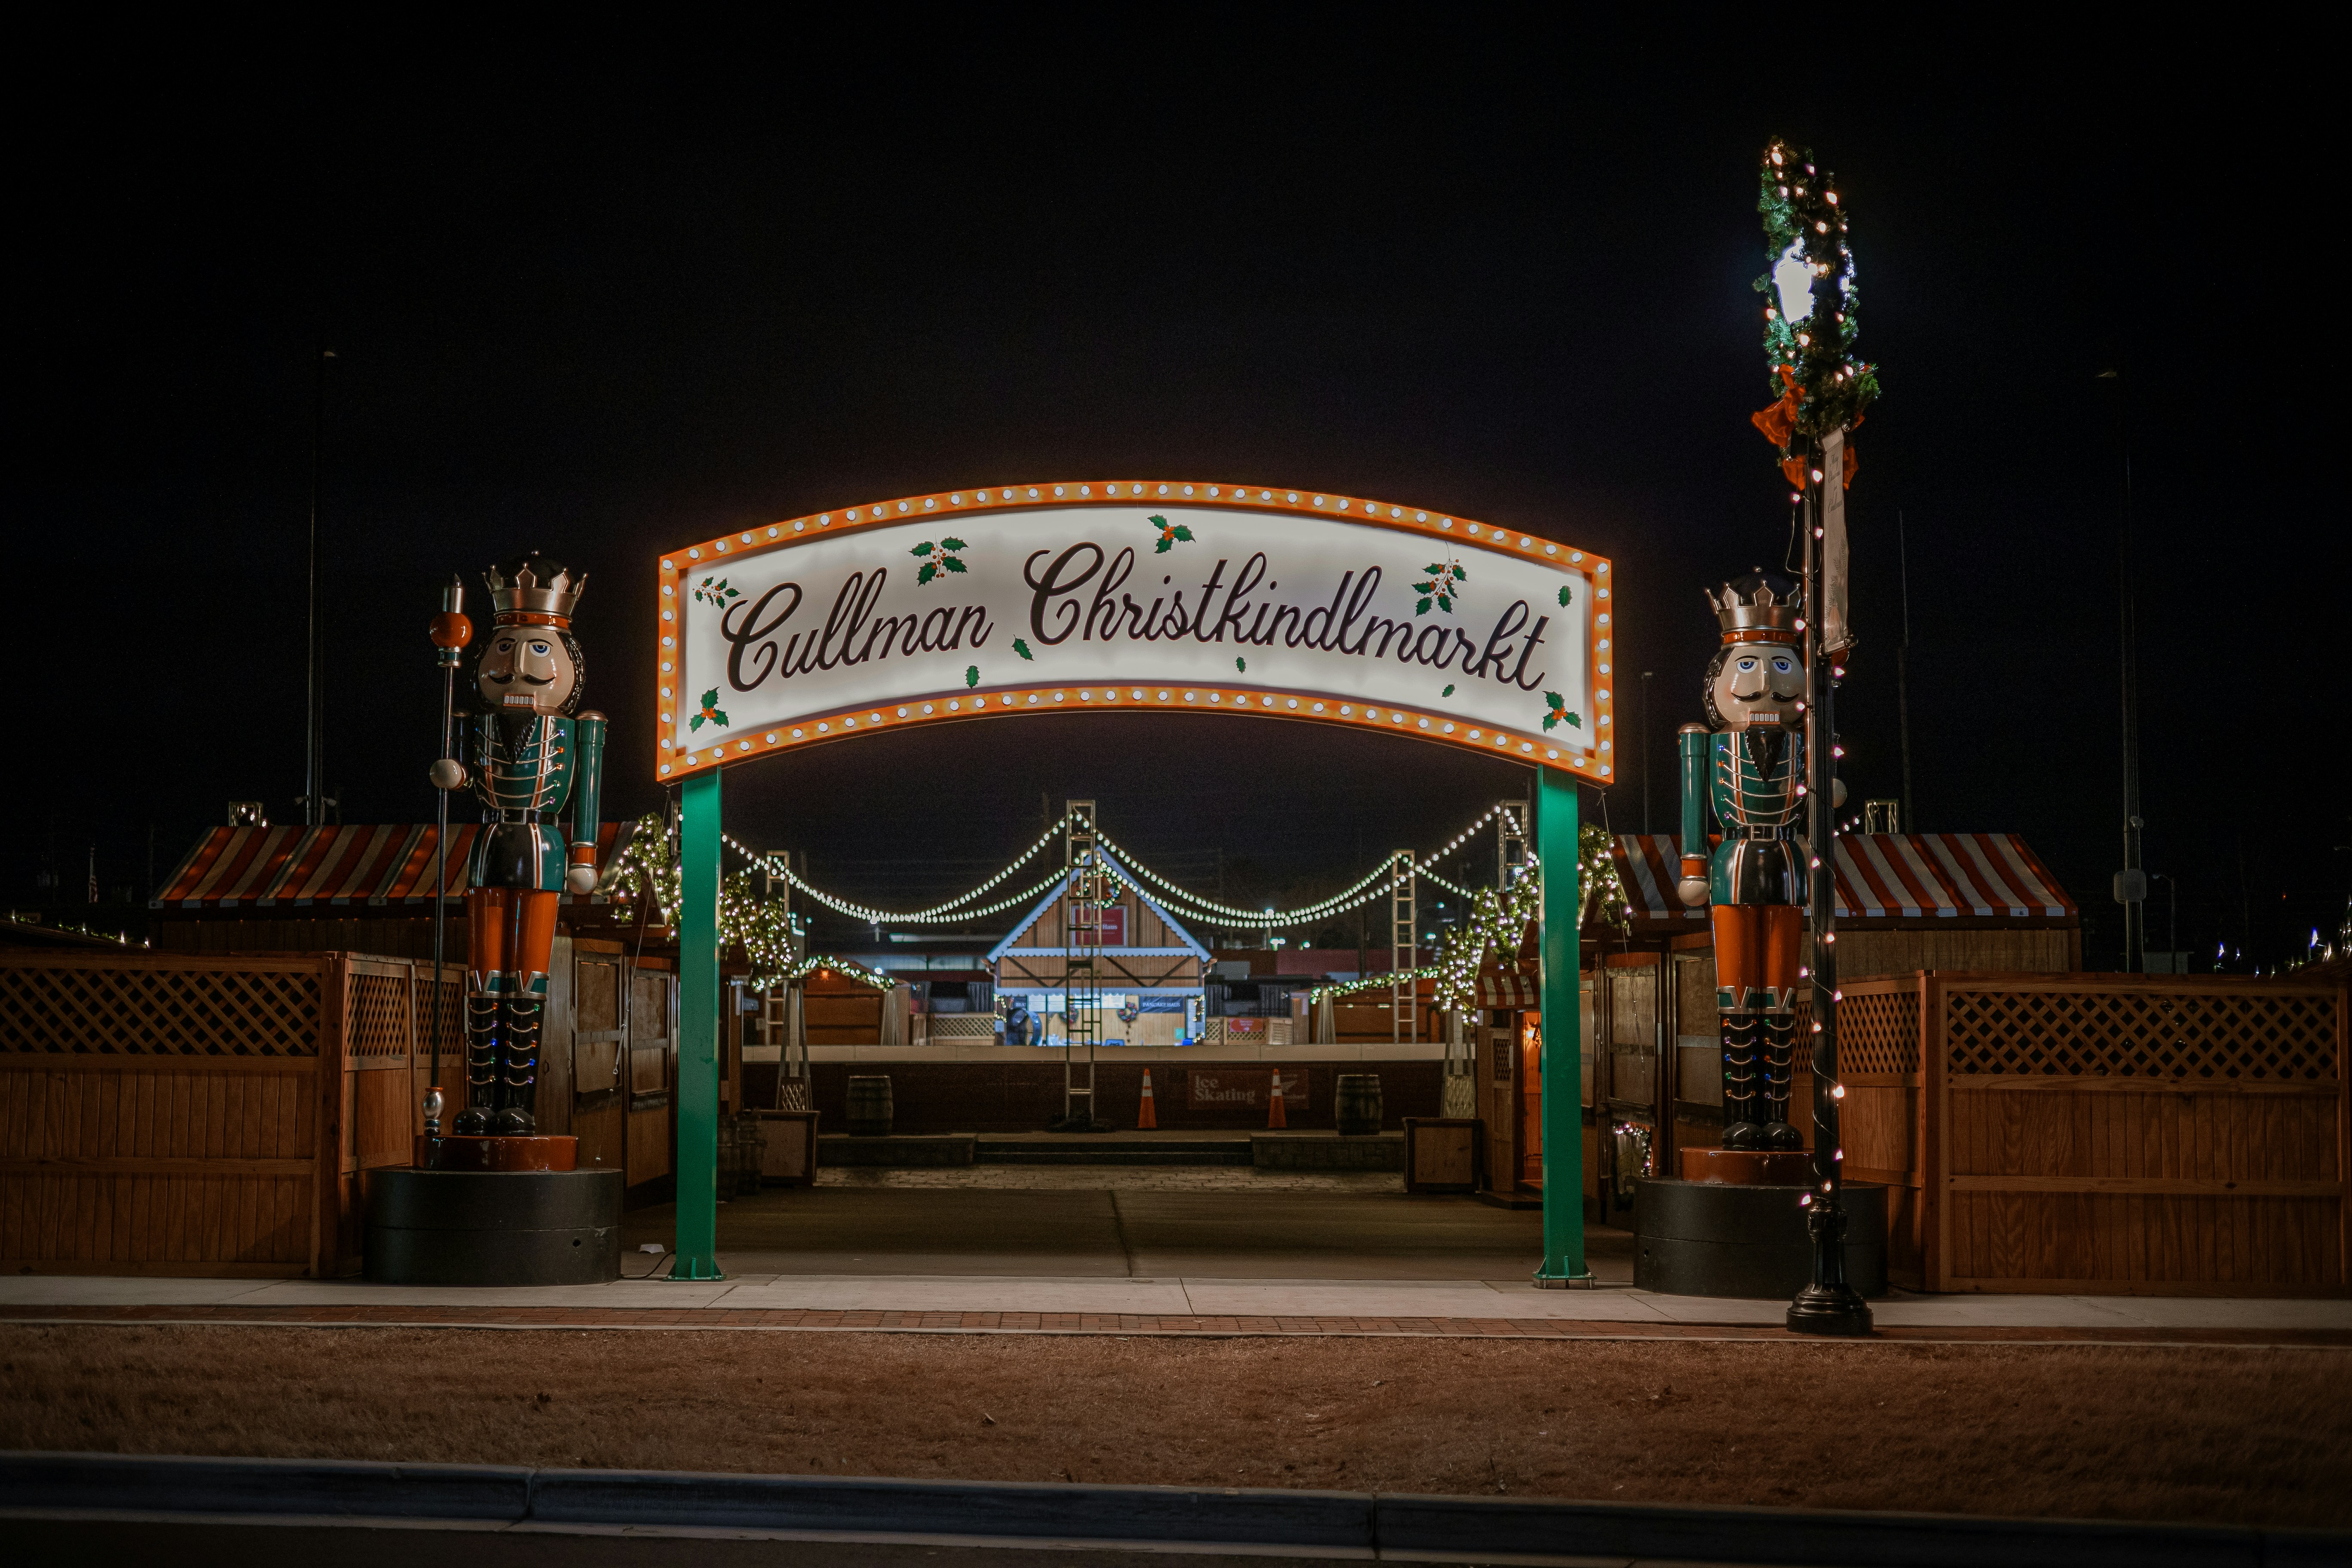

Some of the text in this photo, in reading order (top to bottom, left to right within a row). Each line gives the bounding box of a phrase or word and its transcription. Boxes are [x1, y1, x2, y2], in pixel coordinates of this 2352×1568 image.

[721, 542, 1550, 692] Cullman Christkindlmarkt
[1195, 1075, 1219, 1089] Ice
[1194, 1087, 1256, 1105] Skating
